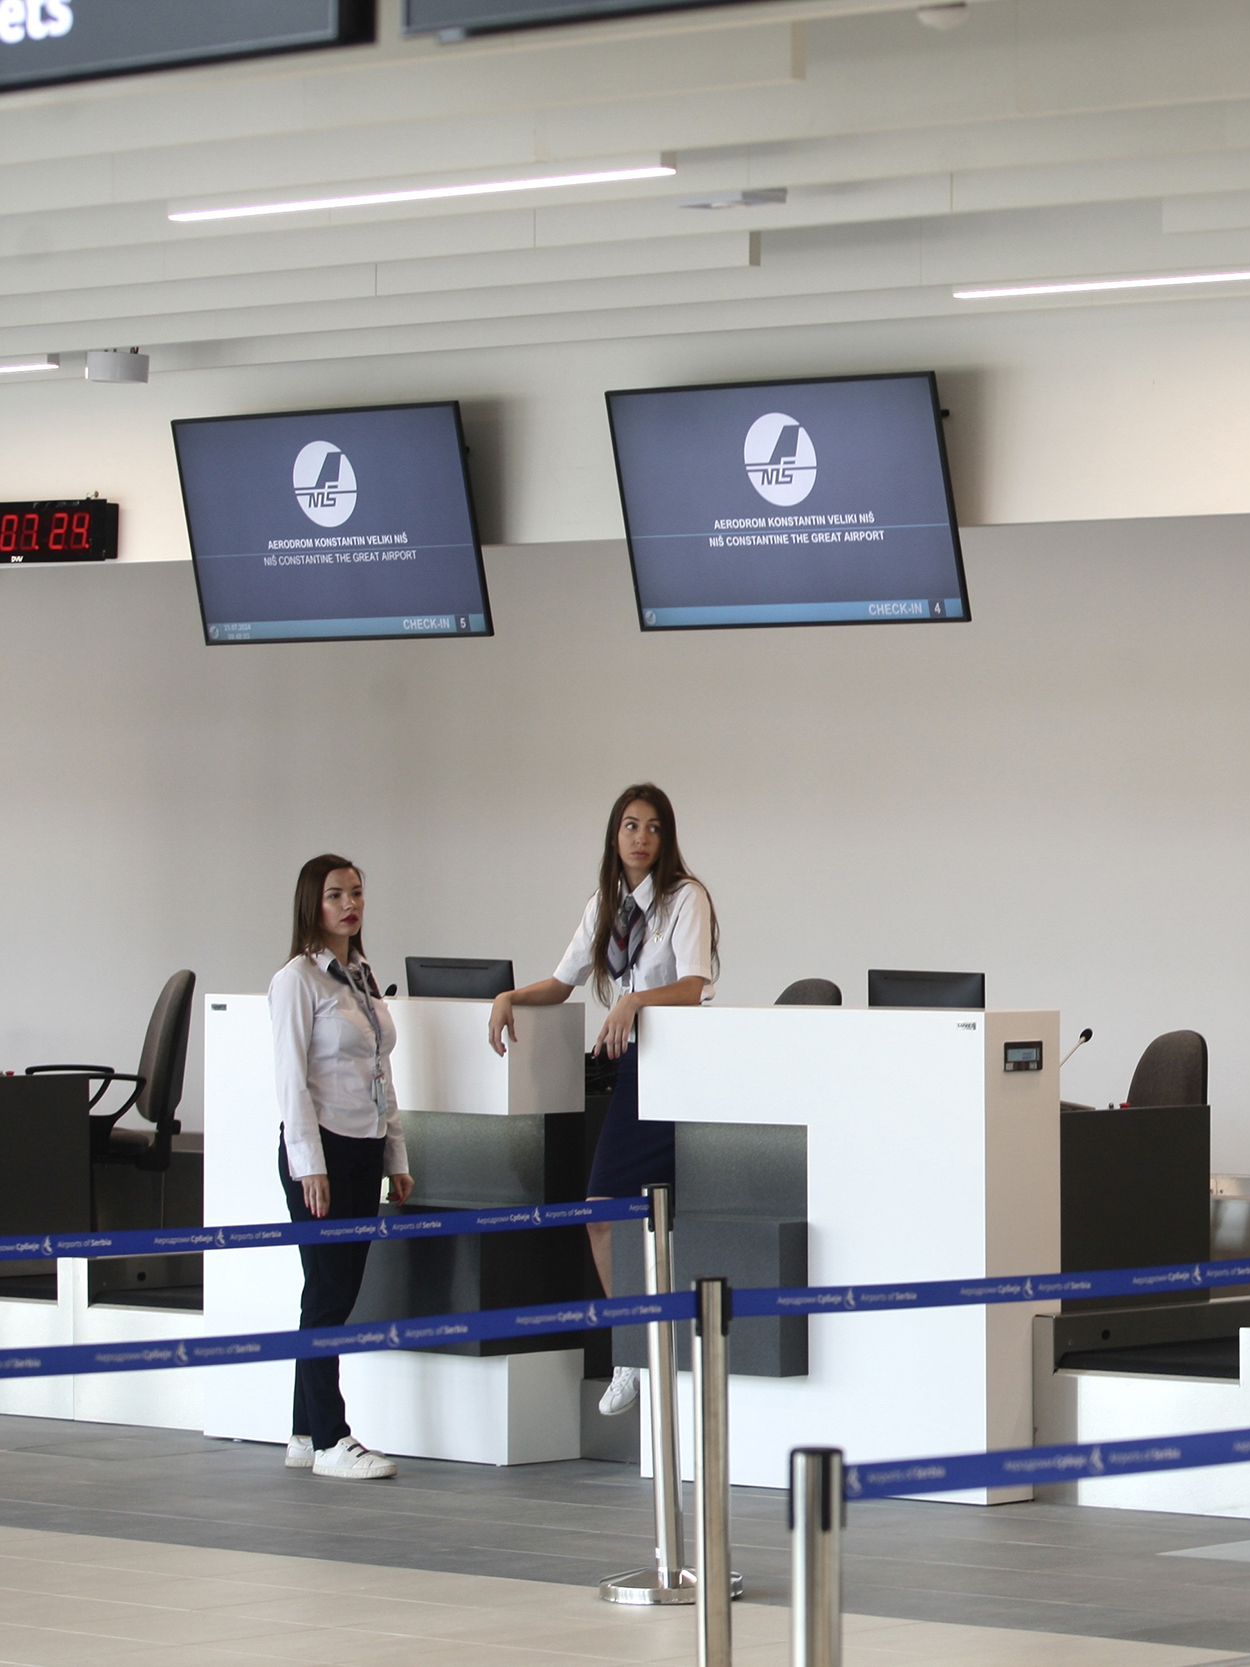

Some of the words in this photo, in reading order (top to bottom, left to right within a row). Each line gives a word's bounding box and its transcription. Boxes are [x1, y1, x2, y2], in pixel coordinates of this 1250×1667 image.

[714, 518, 767, 530] AERODROM
[768, 515, 826, 528] KONSTANTIN
[827, 513, 857, 525] VELIKI
[859, 511, 875, 524] NIŠ
[268, 539, 313, 550] AERODROM
[314, 536, 365, 548] KONSTANTIN
[367, 534, 393, 545] VELIKI
[394, 531, 408, 544] NIŠ
[709, 535, 724, 547] NIŠ
[726, 534, 789, 547] CONSTANTINE
[790, 532, 809, 544] THE
[810, 531, 841, 543] GREAT
[844, 530, 885, 542] AIRPORT
[264, 554, 277, 566] NIŠ
[278, 553, 334, 566] CONSTANTINE
[335, 552, 352, 564] THE
[353, 551, 379, 562] GREAT
[382, 549, 417, 561] AIRPORT
[868, 602, 922, 615] CHECK-IN
[934, 602, 941, 614] 4
[403, 618, 450, 630] CHECK-IN
[460, 617, 467, 628] 5
[574, 1208, 592, 1216] Serbia
[422, 1220, 441, 1228] Serbia
[262, 1230, 282, 1238] Serbia
[91, 1238, 112, 1247] Serbia
